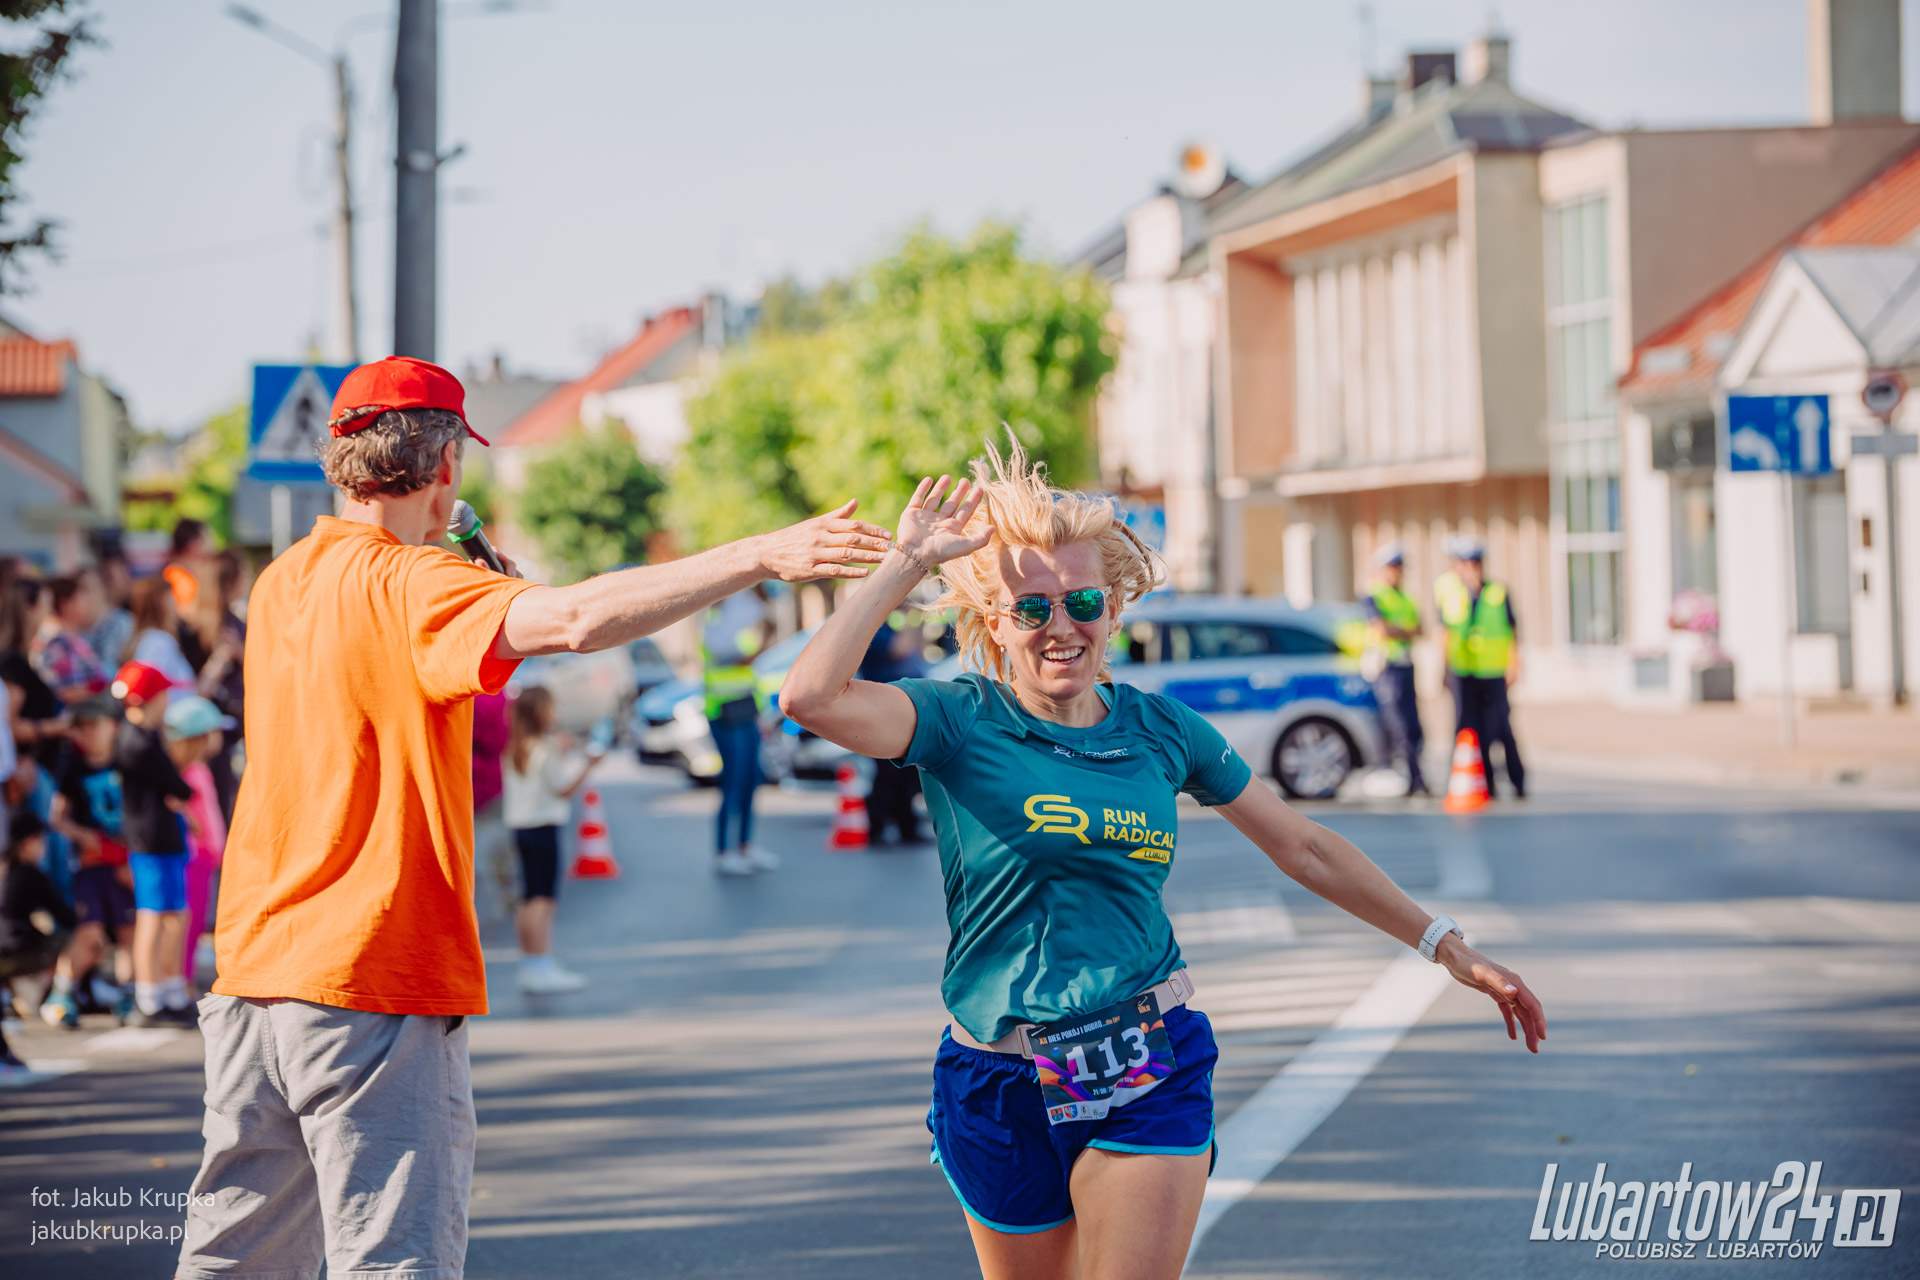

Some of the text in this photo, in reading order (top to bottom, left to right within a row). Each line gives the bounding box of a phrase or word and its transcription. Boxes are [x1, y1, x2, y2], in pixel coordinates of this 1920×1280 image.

[1103, 807, 1147, 827] RUN
[1103, 825, 1175, 849] RADICAL
[1065, 1026, 1150, 1083] 113
